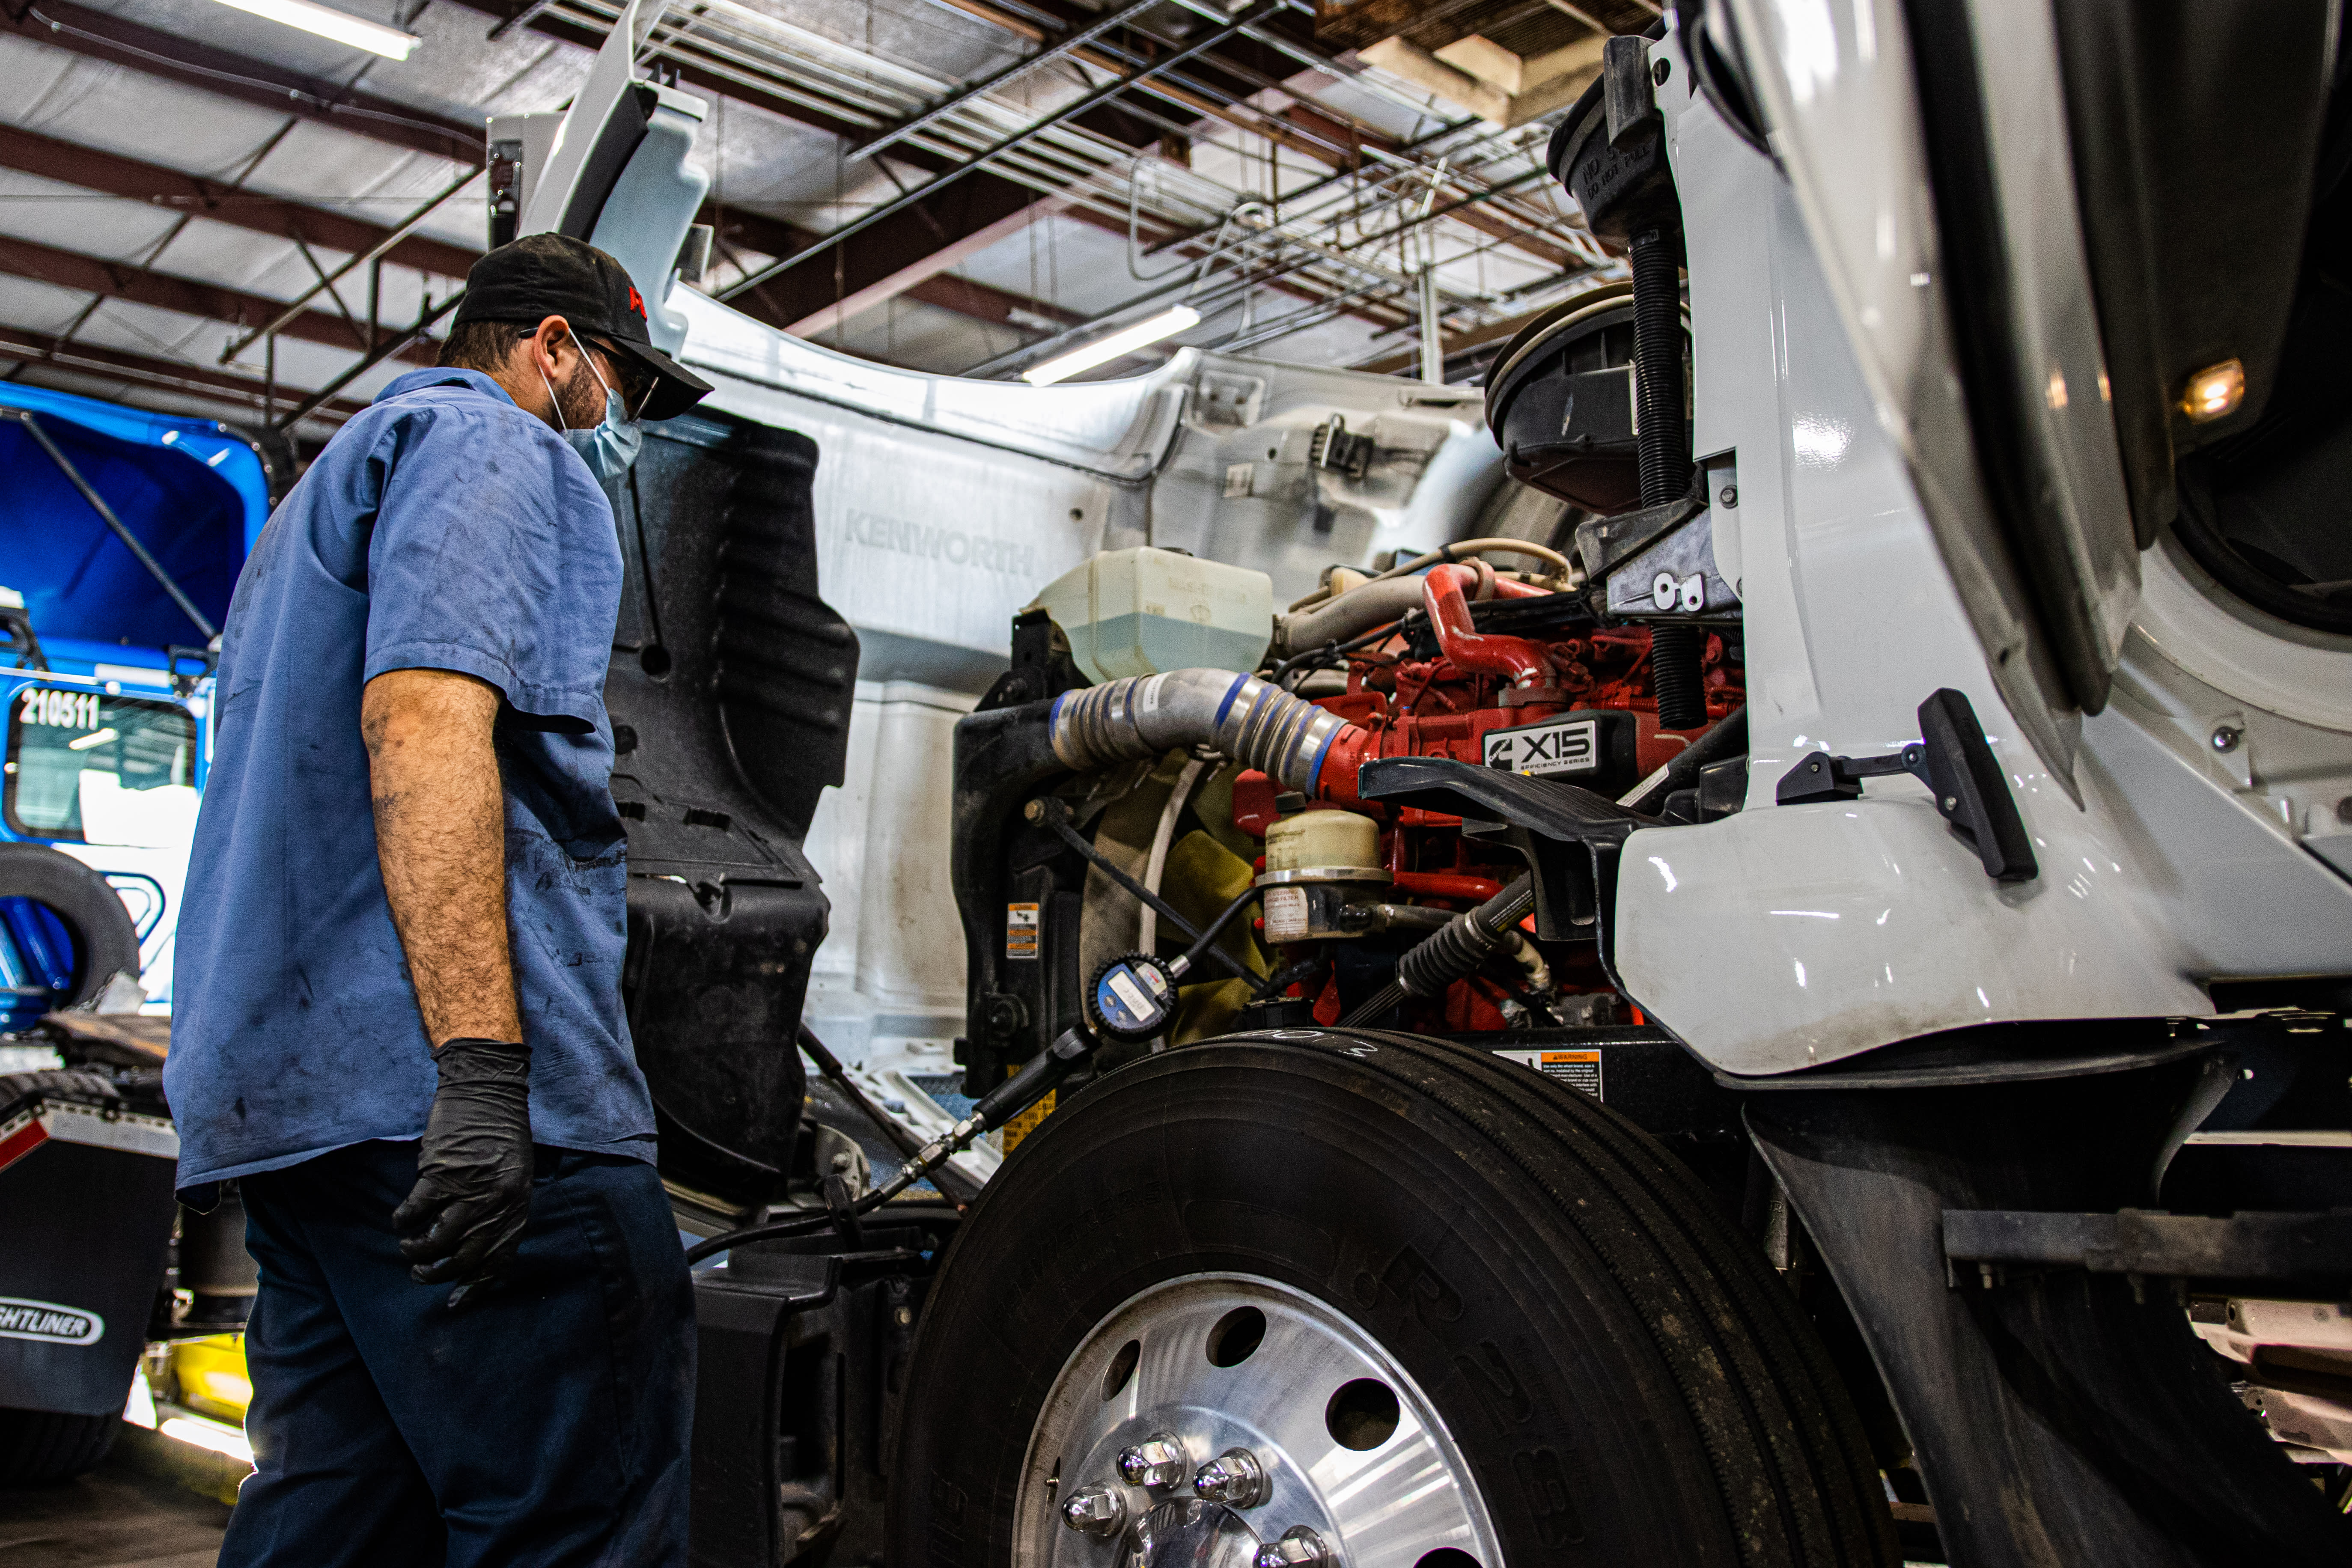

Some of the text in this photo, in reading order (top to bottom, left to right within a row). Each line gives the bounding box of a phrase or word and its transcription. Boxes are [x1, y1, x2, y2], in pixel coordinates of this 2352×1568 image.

[1602, 162, 1619, 185] NOT
[1624, 146, 1650, 167] PULL
[845, 508, 1035, 576] KENWORTH
[20, 687, 101, 730] 210511
[1521, 727, 1590, 763] X15
[1520, 761, 1561, 770] EFFICIENCY
